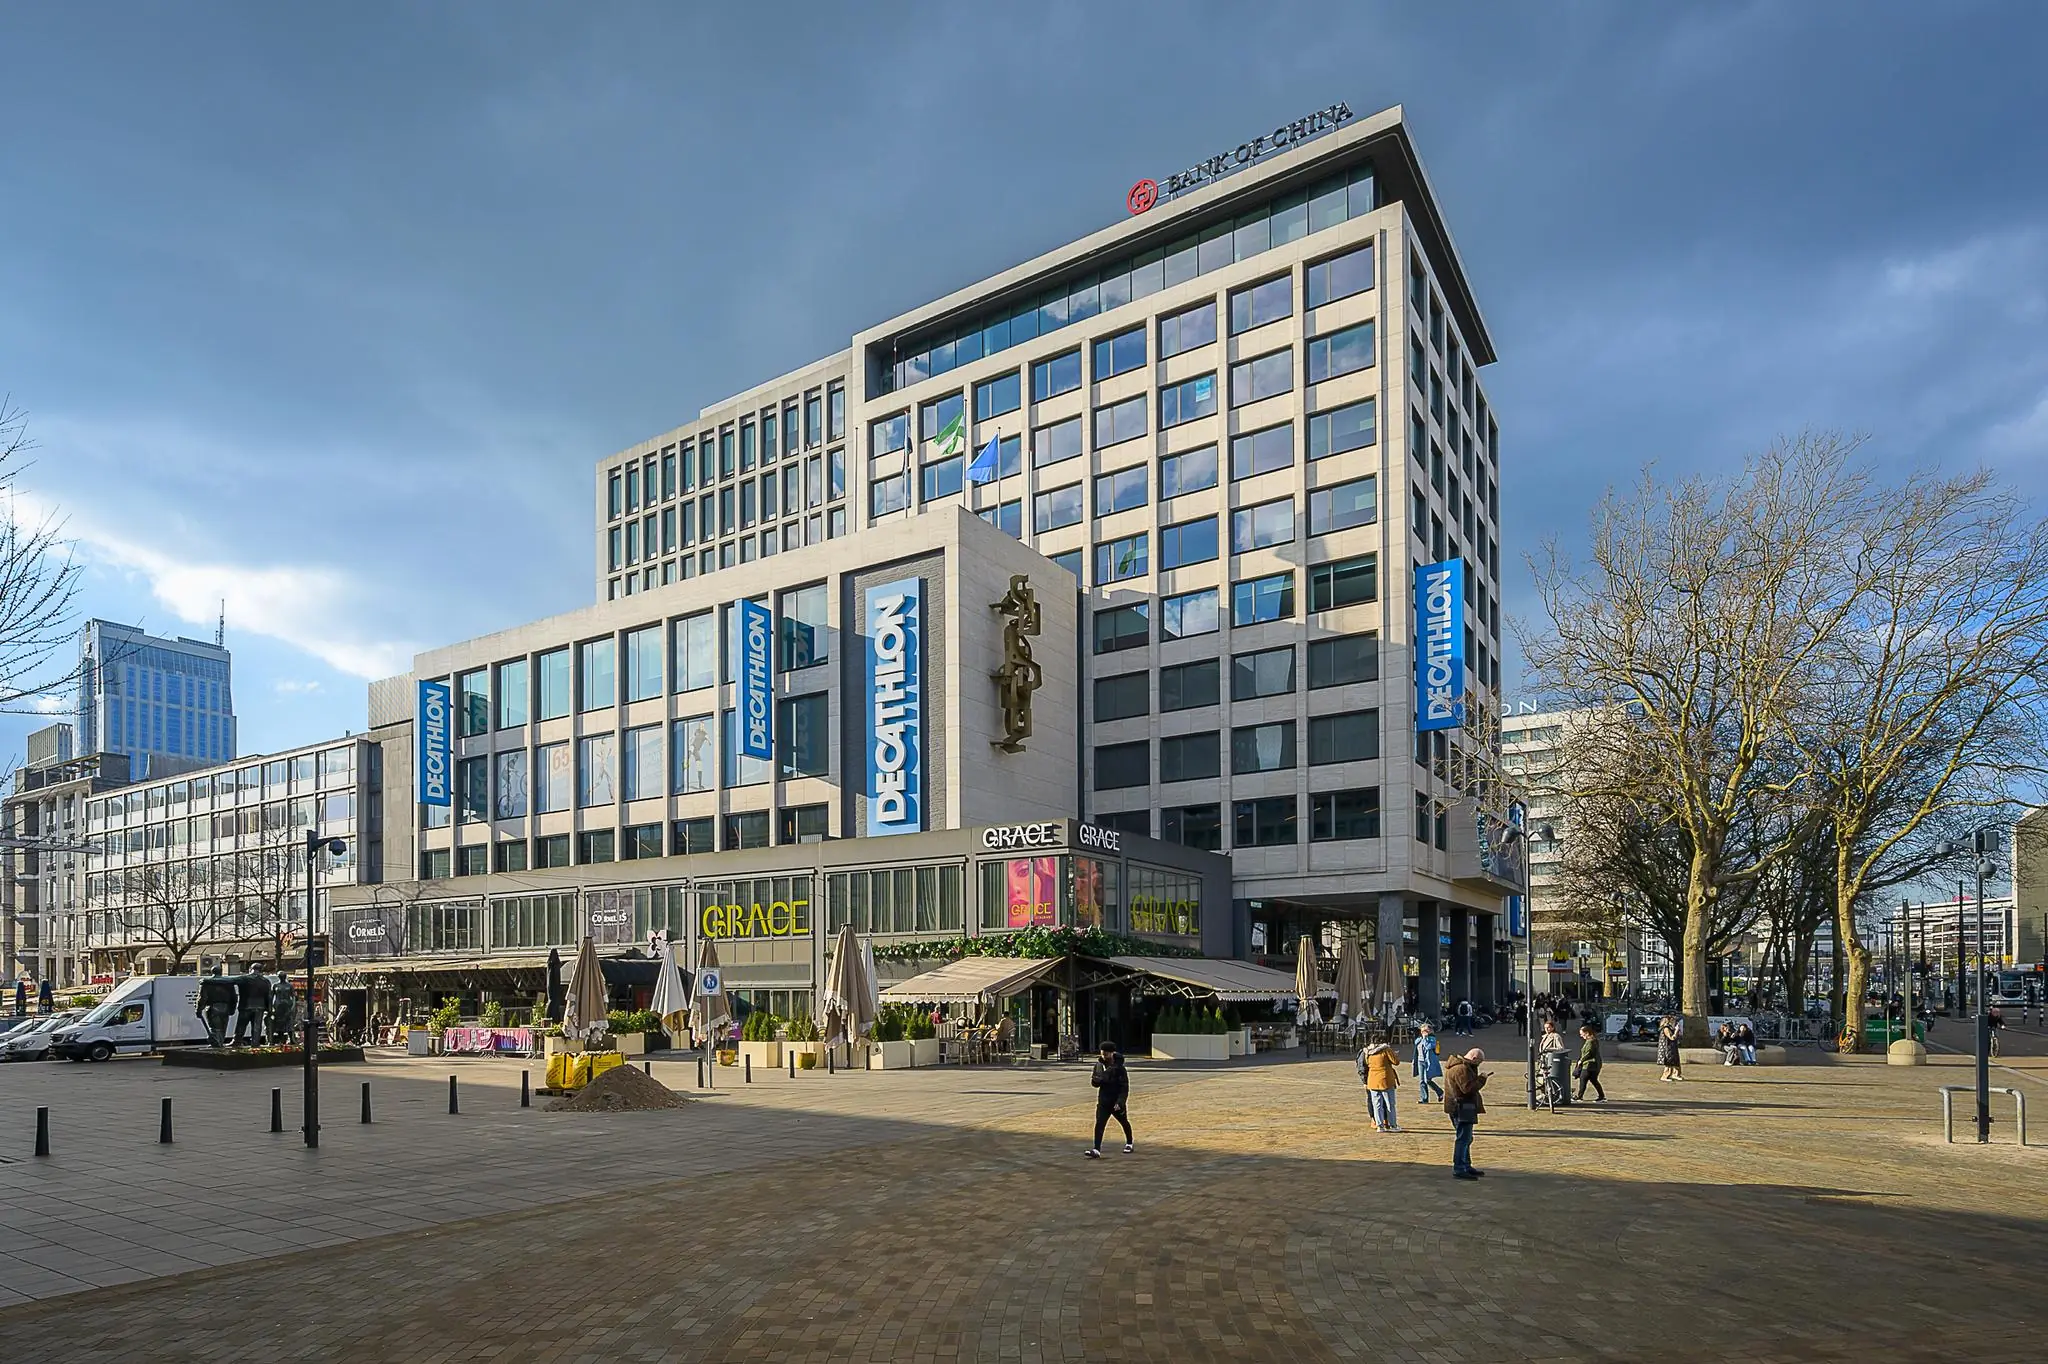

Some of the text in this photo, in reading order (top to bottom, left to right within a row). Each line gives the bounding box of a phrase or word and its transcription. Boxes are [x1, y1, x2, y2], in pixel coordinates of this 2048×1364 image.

[1168, 100, 1354, 194] BANK OF CHINA
[748, 611, 766, 750] DECATHLON
[1426, 570, 1452, 720] DECATHLON
[426, 688, 444, 799] DECATHLON
[875, 593, 906, 823] DECATHLON
[983, 823, 1054, 848] GRACE
[1080, 824, 1120, 851] GRACE
[349, 924, 386, 938] CORNELIS
[703, 901, 809, 938] GRACE
